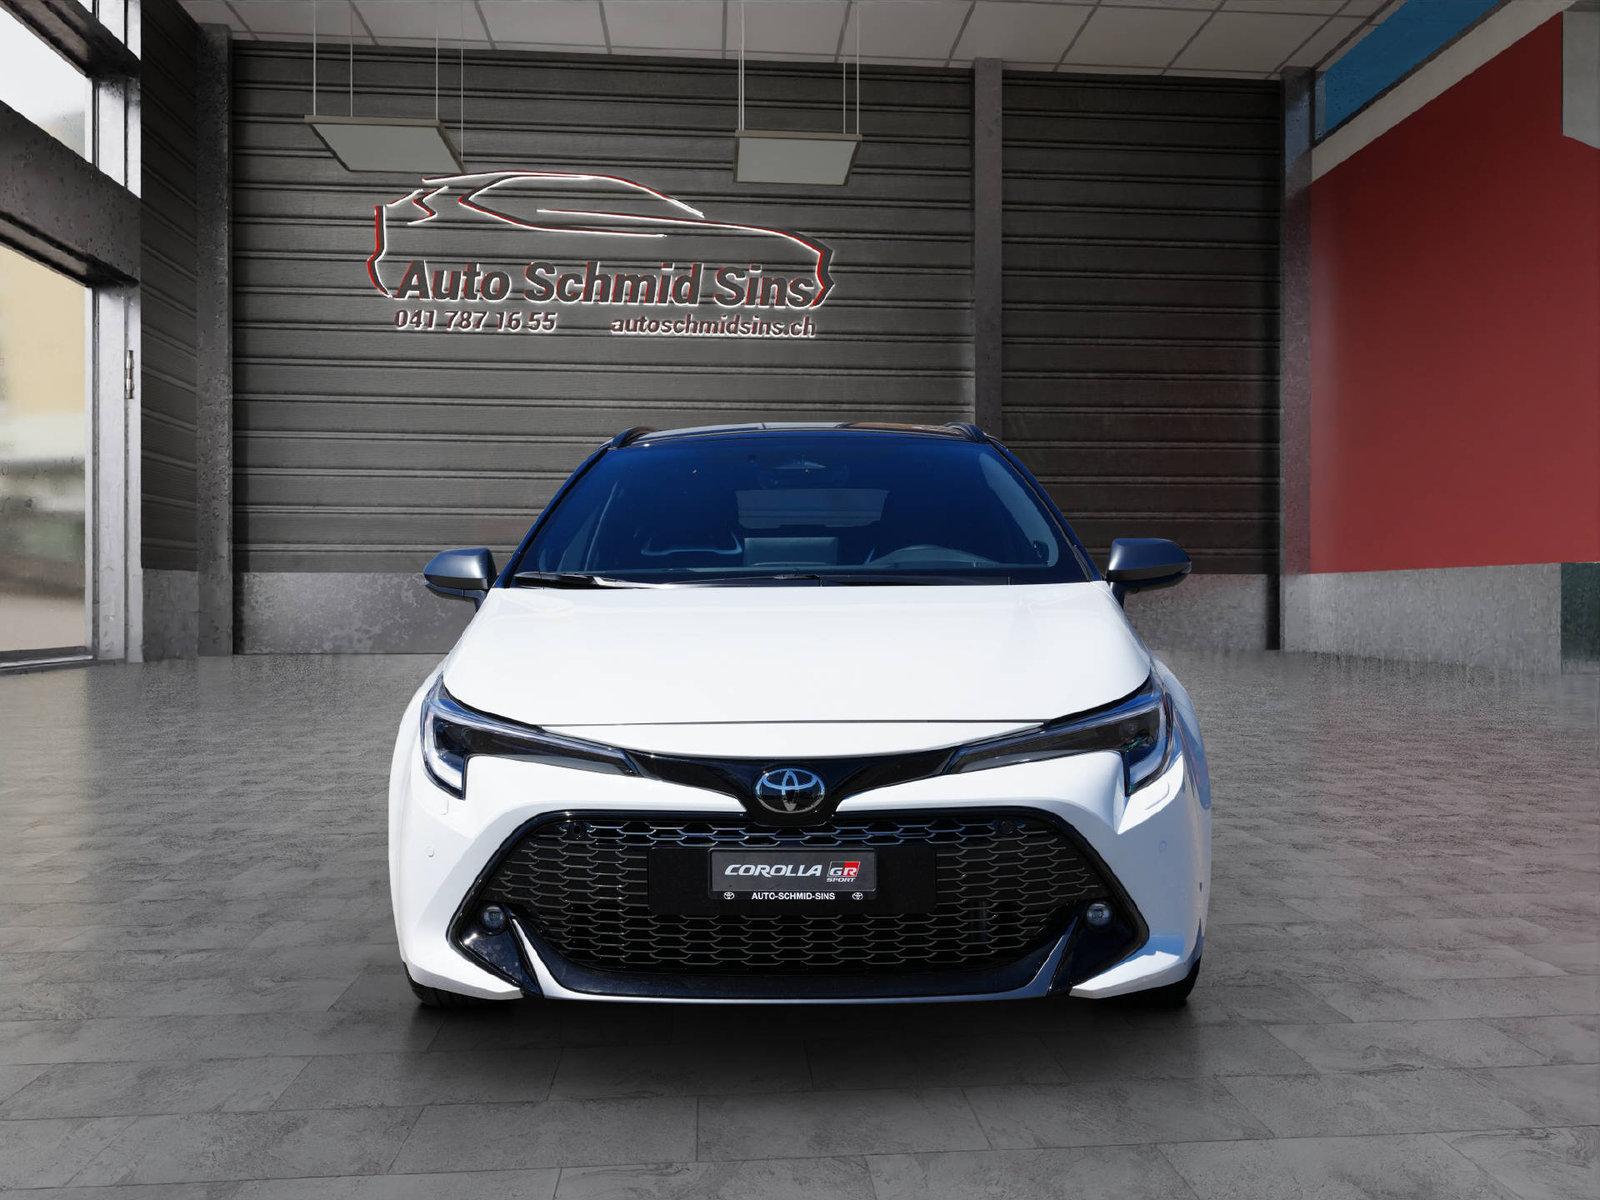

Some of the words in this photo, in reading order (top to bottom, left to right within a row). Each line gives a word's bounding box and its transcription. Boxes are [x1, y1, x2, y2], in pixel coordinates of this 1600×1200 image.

[394, 260, 512, 301] Auto
[523, 260, 705, 305] Schmid
[713, 264, 816, 309] Sins
[393, 309, 436, 330] 041
[445, 309, 487, 331] 787
[495, 310, 523, 332] 16
[527, 311, 558, 332] 55
[609, 314, 817, 338] autoschmidsins.ch
[724, 864, 823, 878] COROLLA
[828, 865, 859, 877] GR
[751, 892, 836, 900] AUTO-SCHMID-SINS
